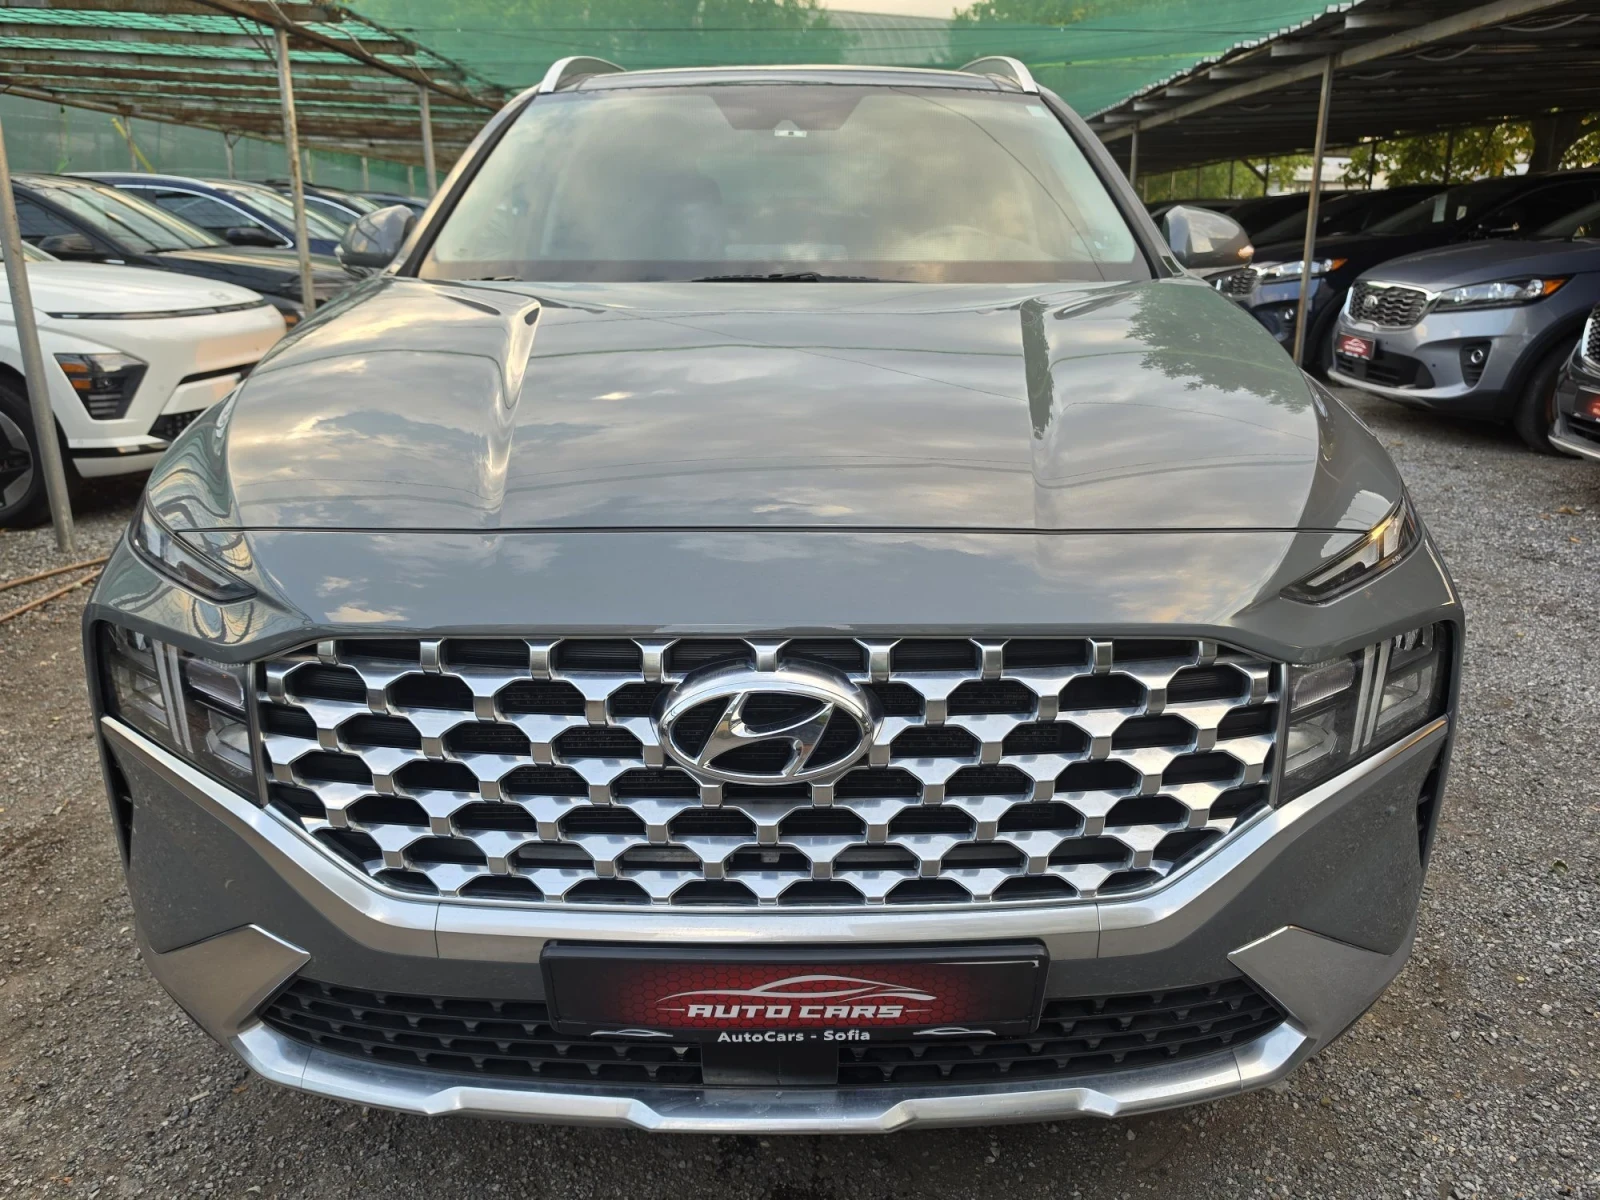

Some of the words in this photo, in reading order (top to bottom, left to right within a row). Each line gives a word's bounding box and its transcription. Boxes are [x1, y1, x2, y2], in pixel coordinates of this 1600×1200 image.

[687, 1004, 792, 1019] AUTO
[798, 1005, 904, 1019] CARS
[717, 1031, 804, 1043] AutoCars
[823, 1029, 871, 1041] Sofia
